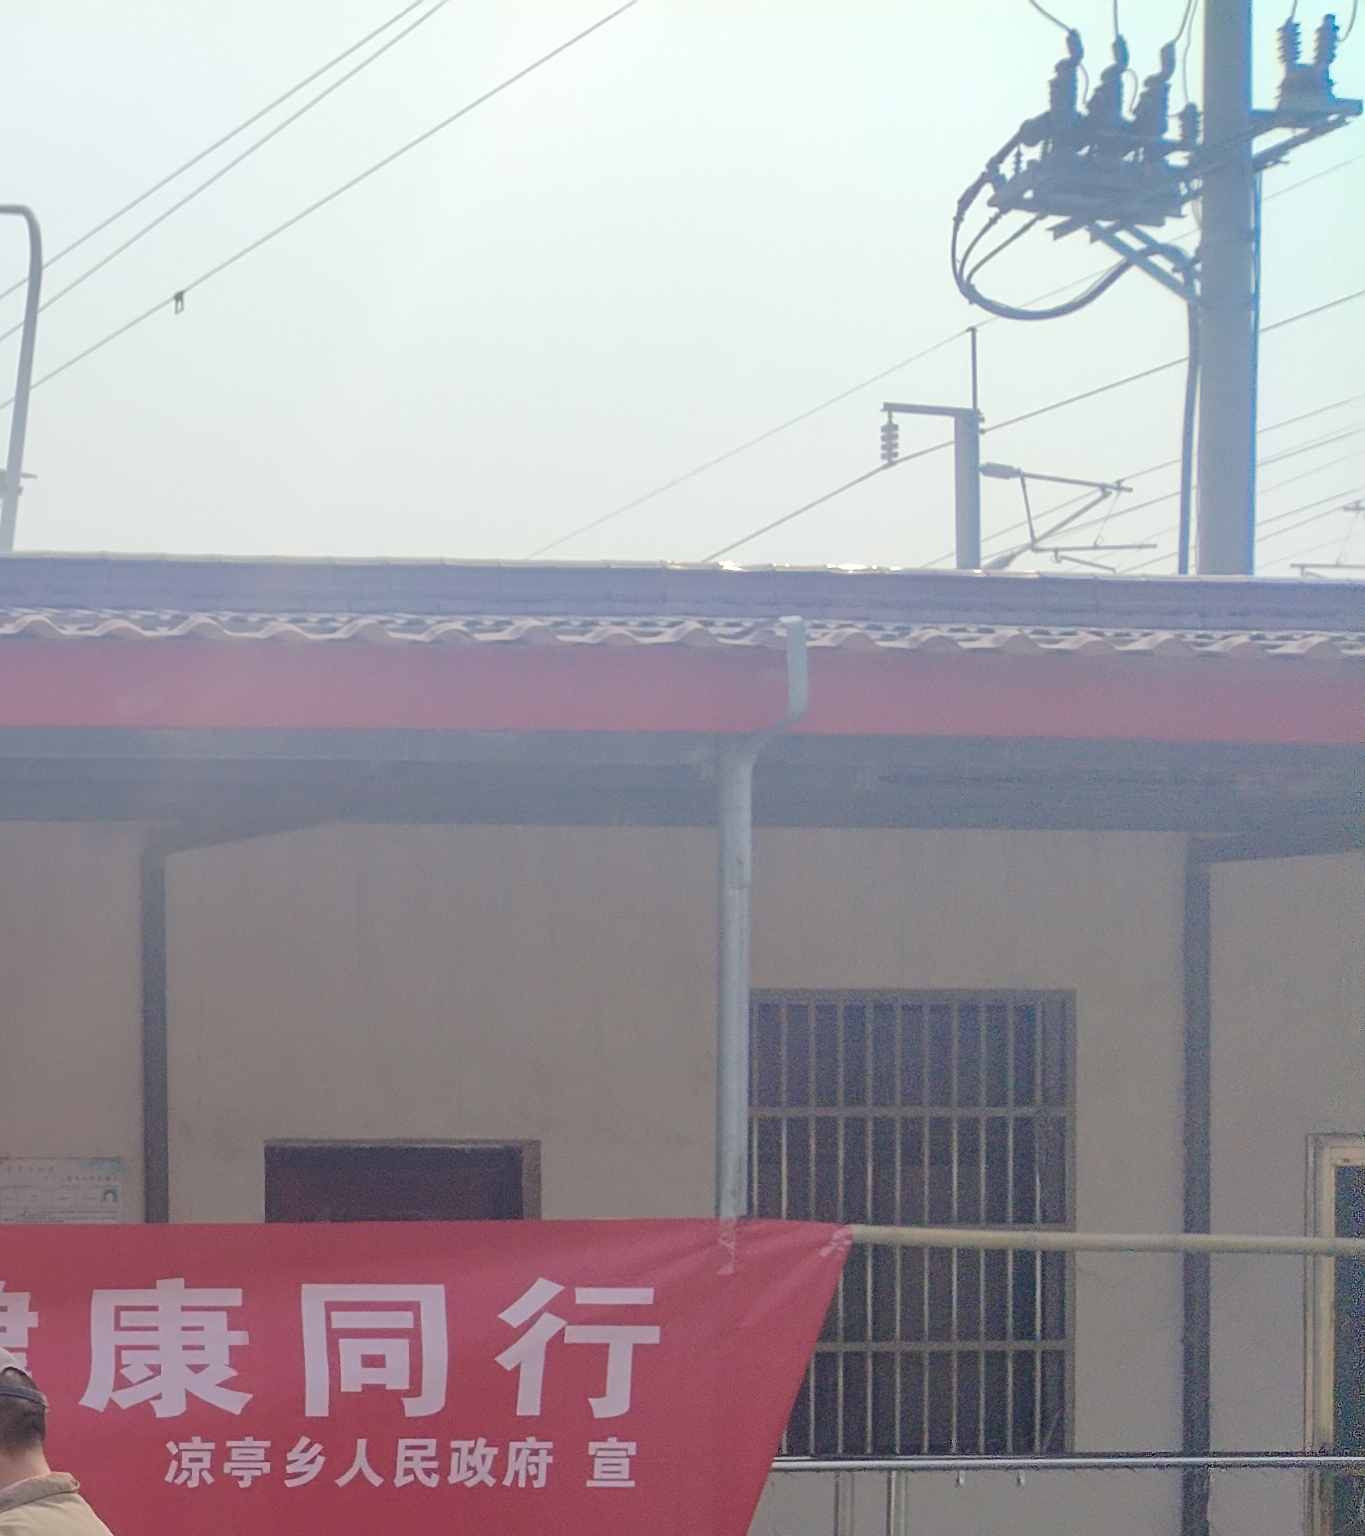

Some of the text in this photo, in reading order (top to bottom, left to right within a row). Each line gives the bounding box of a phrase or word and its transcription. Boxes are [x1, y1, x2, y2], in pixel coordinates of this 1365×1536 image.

[163, 1436, 637, 1489] 凉亭乡人民政府 宣
